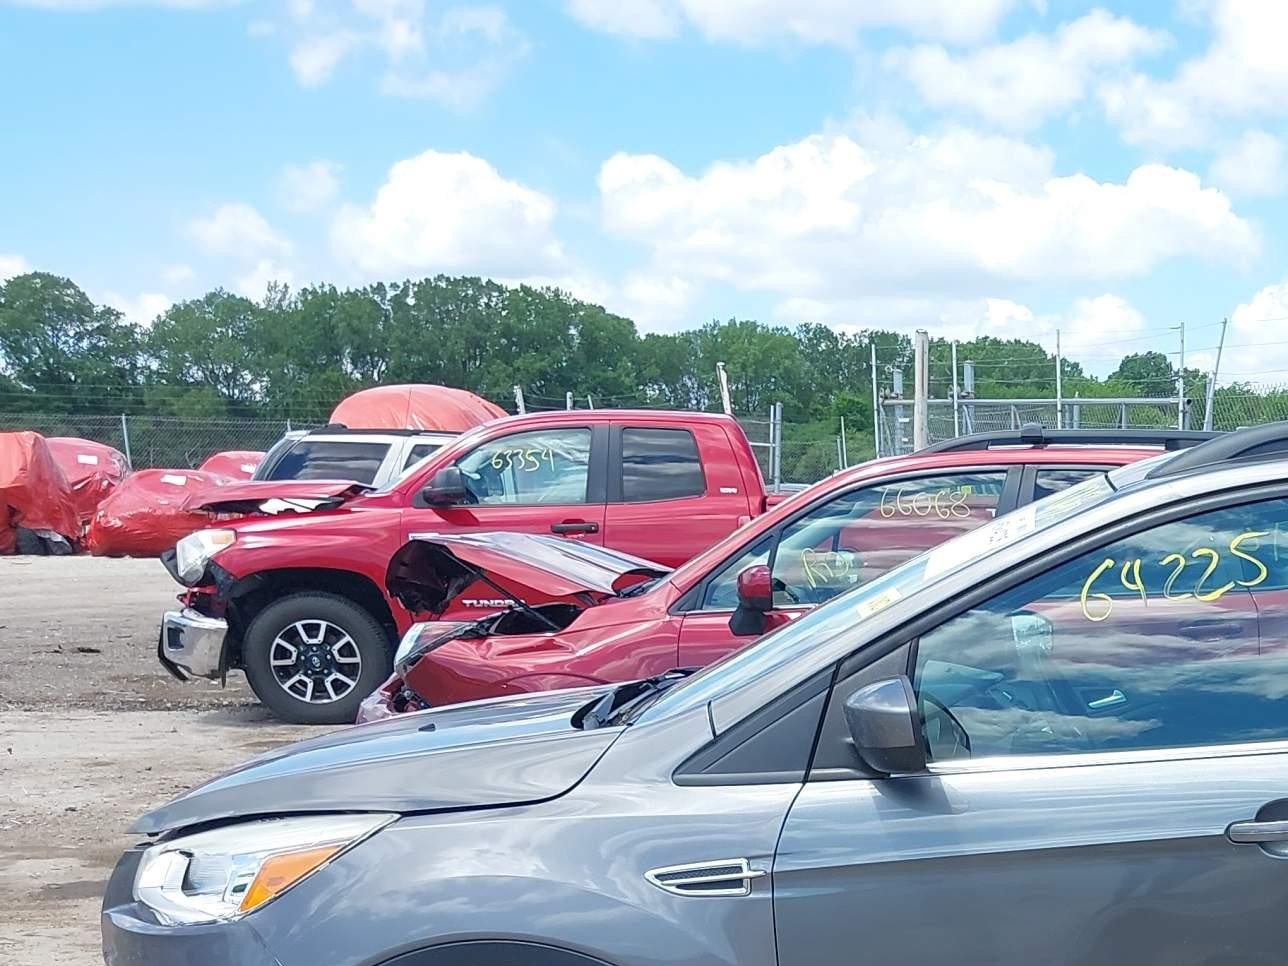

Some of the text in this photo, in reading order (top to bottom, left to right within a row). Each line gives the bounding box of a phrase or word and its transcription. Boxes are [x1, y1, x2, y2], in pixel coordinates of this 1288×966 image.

[491, 448, 555, 472] 63354
[880, 487, 971, 519] 66068
[1081, 531, 1269, 622] 64225
